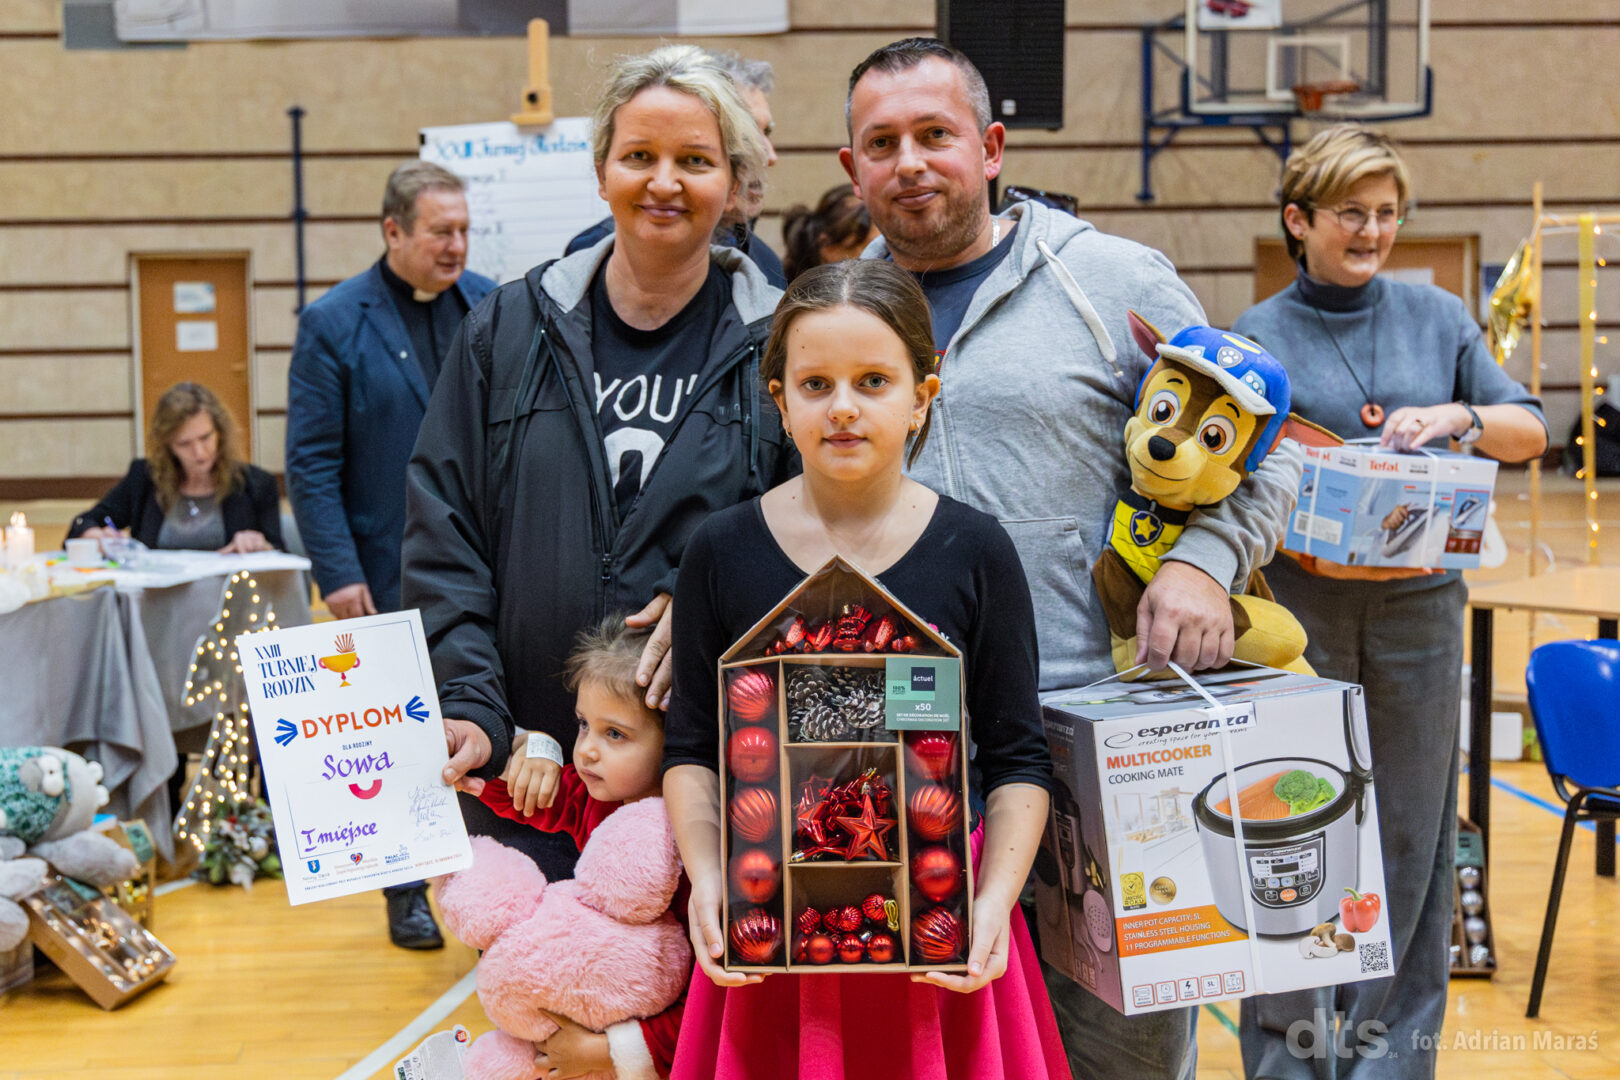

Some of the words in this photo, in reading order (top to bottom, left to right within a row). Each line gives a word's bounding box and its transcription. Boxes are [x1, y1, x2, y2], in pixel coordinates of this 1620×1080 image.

[1369, 459, 1399, 472] Tefal
[254, 643, 281, 660] XXIII
[257, 654, 318, 679] TURNIEJ
[262, 675, 316, 699] RODZIN
[915, 703, 932, 711] x50
[301, 703, 403, 739] DYPLOM
[1137, 714, 1249, 738] esperanza
[1138, 738, 1168, 747] creating
[1170, 735, 1188, 744] space
[1190, 732, 1202, 740] for
[322, 751, 395, 781] Sowa
[1106, 743, 1212, 770] MULTICOOKER
[1108, 770, 1156, 785] COOKING
[1157, 766, 1184, 778] MATE
[317, 820, 379, 847] miejsce
[1123, 920, 1144, 930] INNER
[1144, 918, 1158, 928] POT
[1159, 914, 1193, 925] CAPACITY:
[1194, 912, 1202, 920] 5L
[1124, 929, 1159, 941] STAINLESS
[1159, 927, 1179, 937] STEEL
[1179, 921, 1211, 933] HOUSING
[1125, 943, 1134, 951] 11
[1134, 936, 1191, 950] PROGRAMMABLE
[1191, 929, 1231, 941] FUNCTIONS
